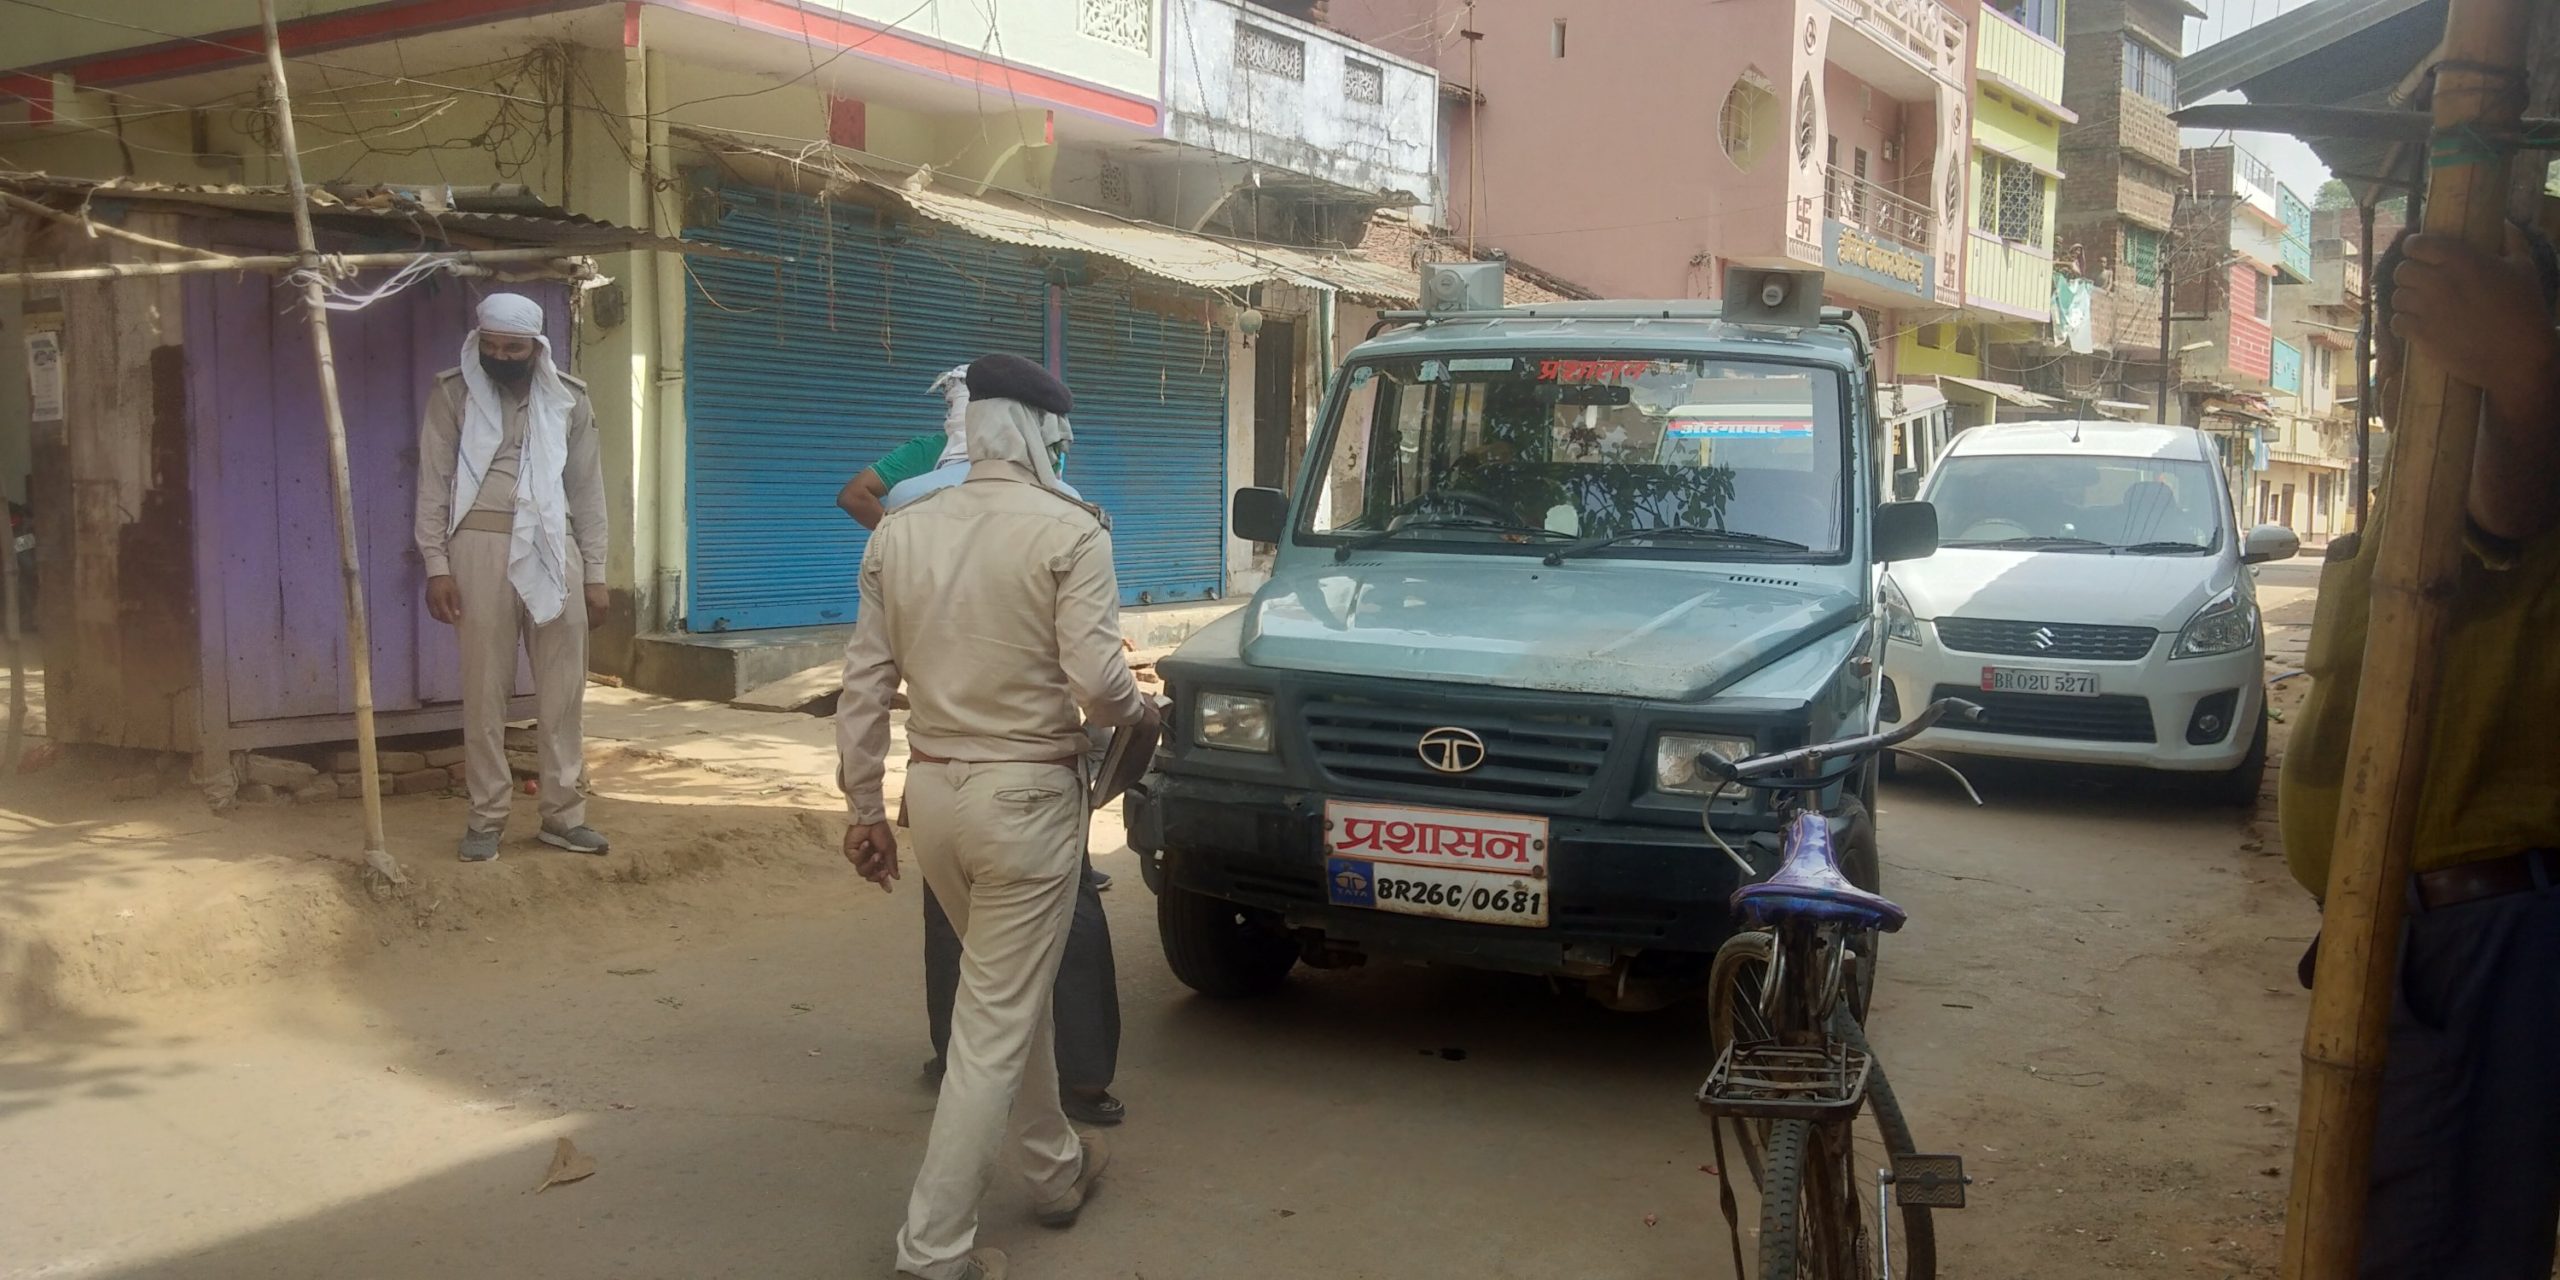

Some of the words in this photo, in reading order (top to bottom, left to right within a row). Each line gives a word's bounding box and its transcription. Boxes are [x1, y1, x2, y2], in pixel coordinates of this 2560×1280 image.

[2054, 677, 2095, 694] 5271
[1336, 817, 1532, 862] प्रशासन
[1377, 878, 1541, 915] BR26C/0681
